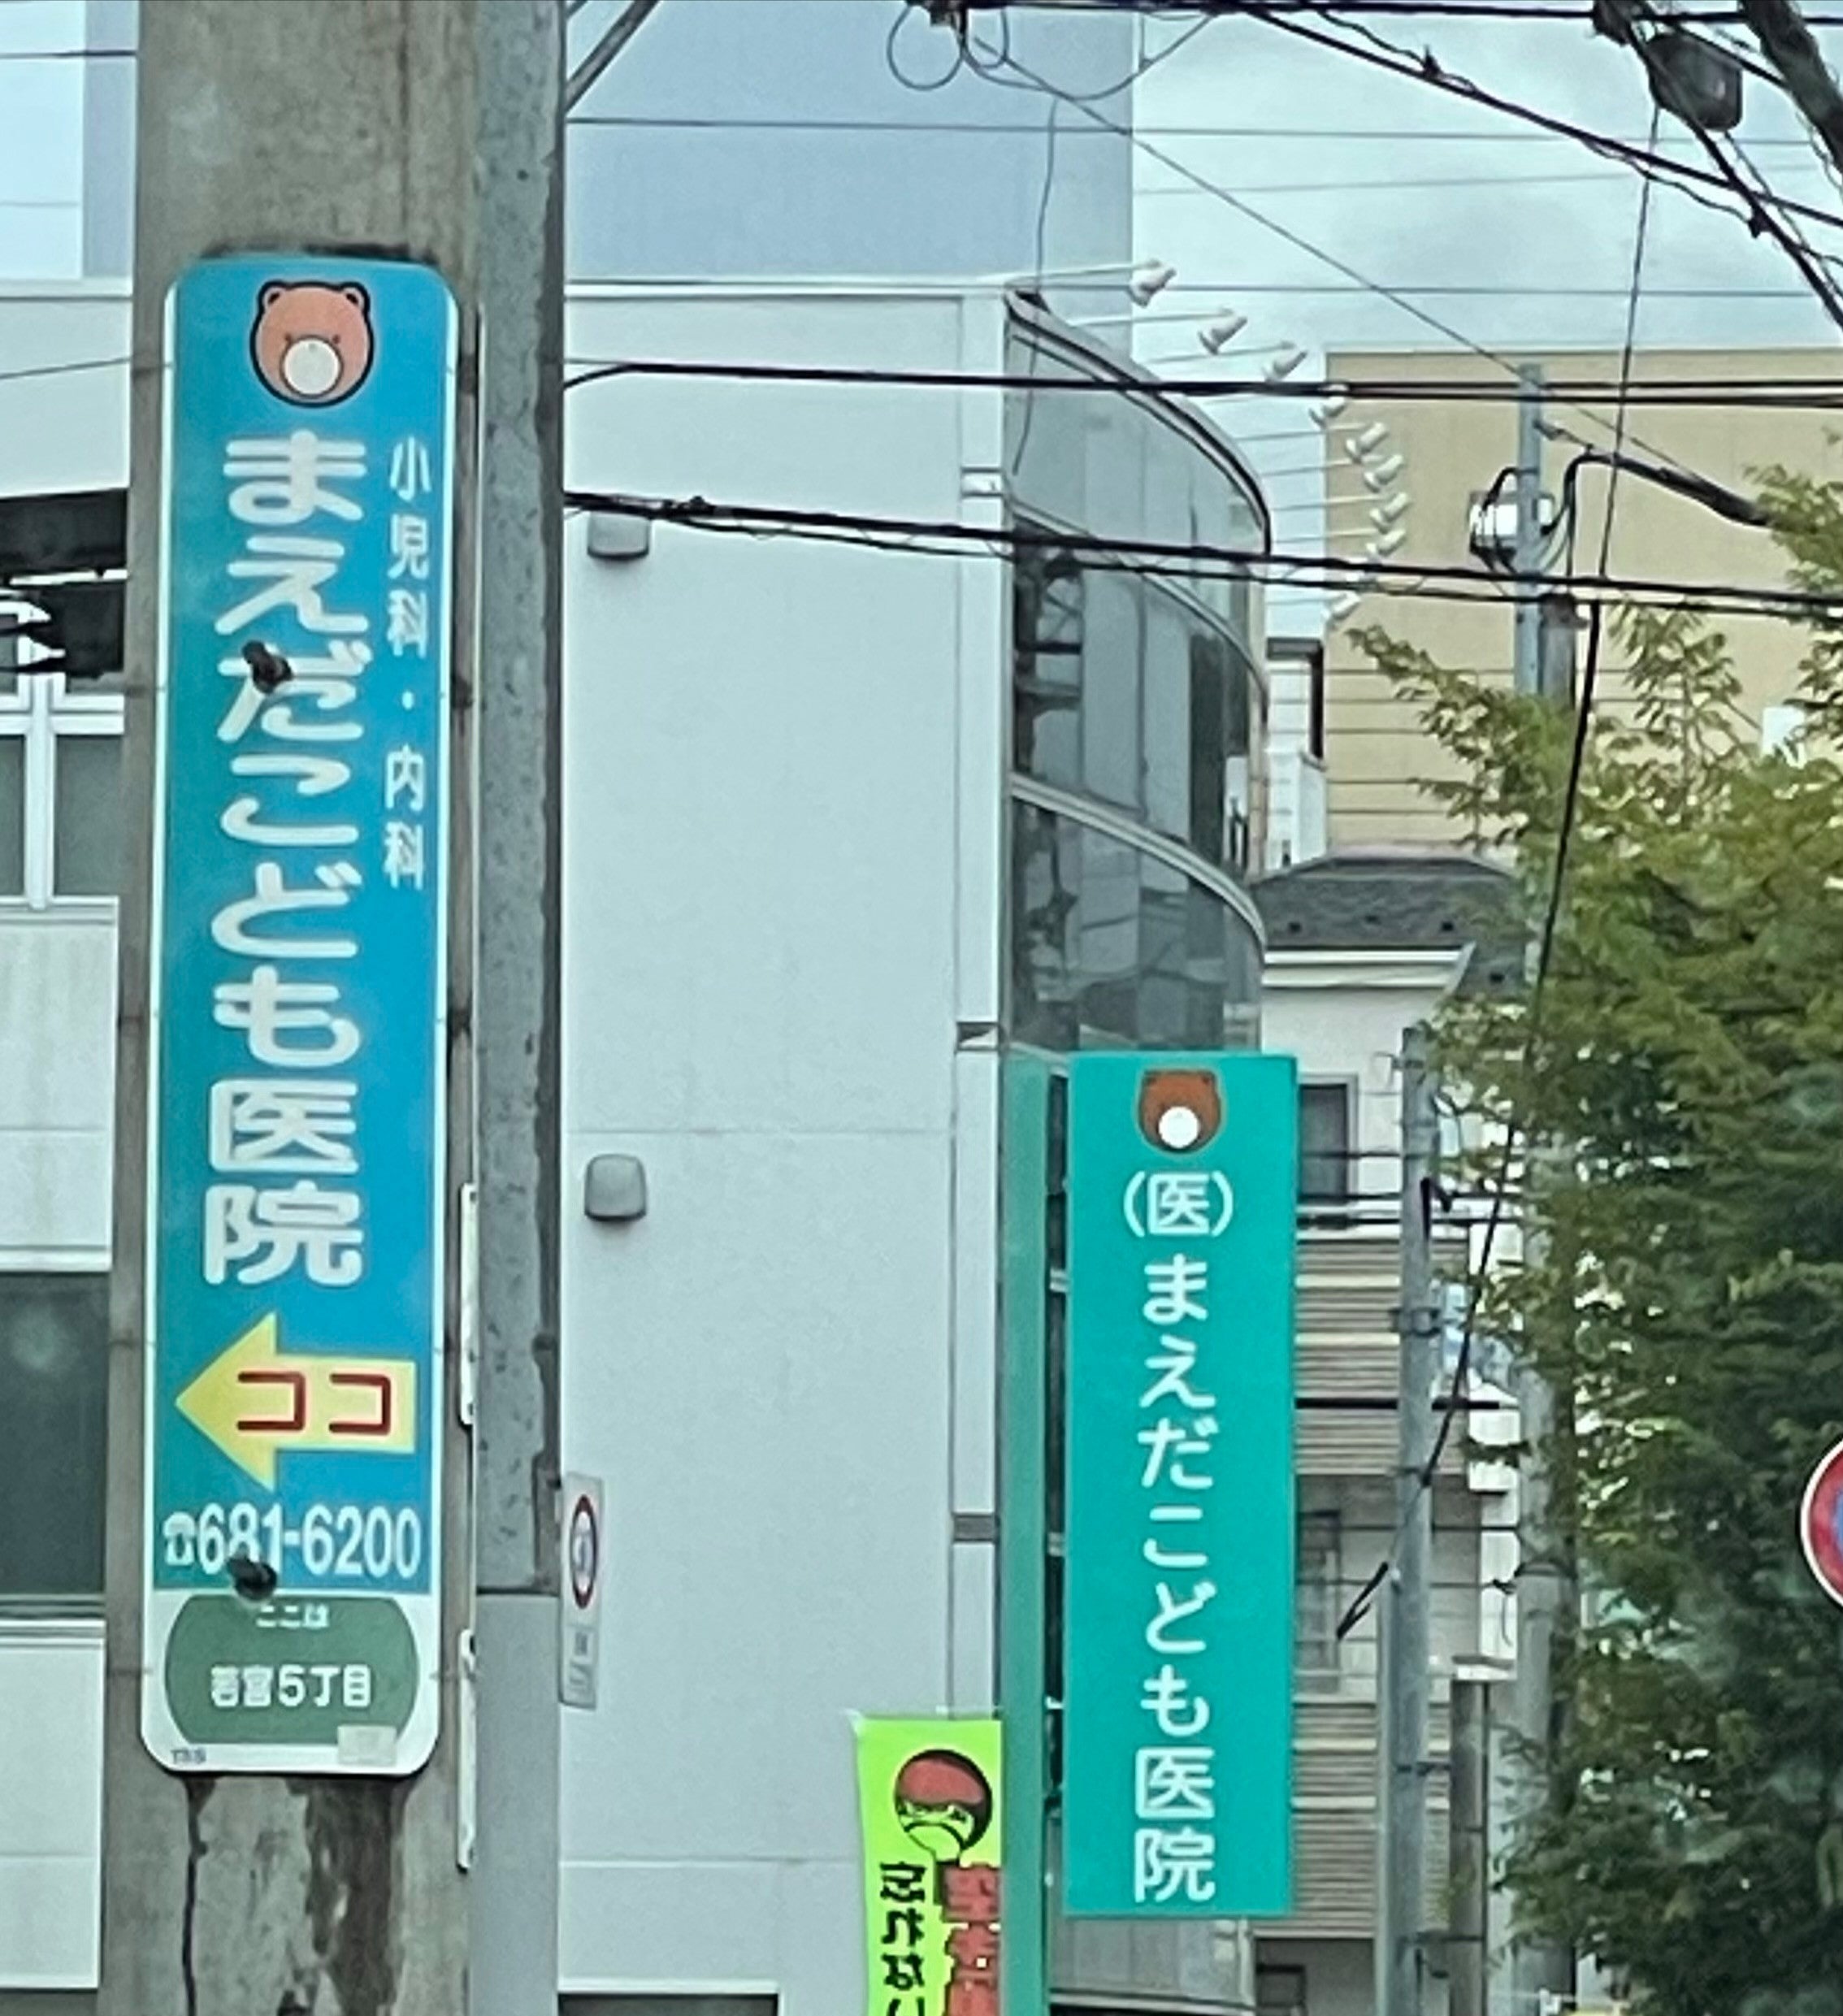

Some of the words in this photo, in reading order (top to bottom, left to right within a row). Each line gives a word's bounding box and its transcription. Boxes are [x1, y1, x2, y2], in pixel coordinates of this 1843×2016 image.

[204, 429, 374, 1285] まえだこども医院
[384, 436, 431, 889] 小児科・内科
[197, 1502, 422, 1579] 681-6200
[236, 1372, 392, 1435] ココ
[1134, 1254, 1218, 1902] まえだこども医院
